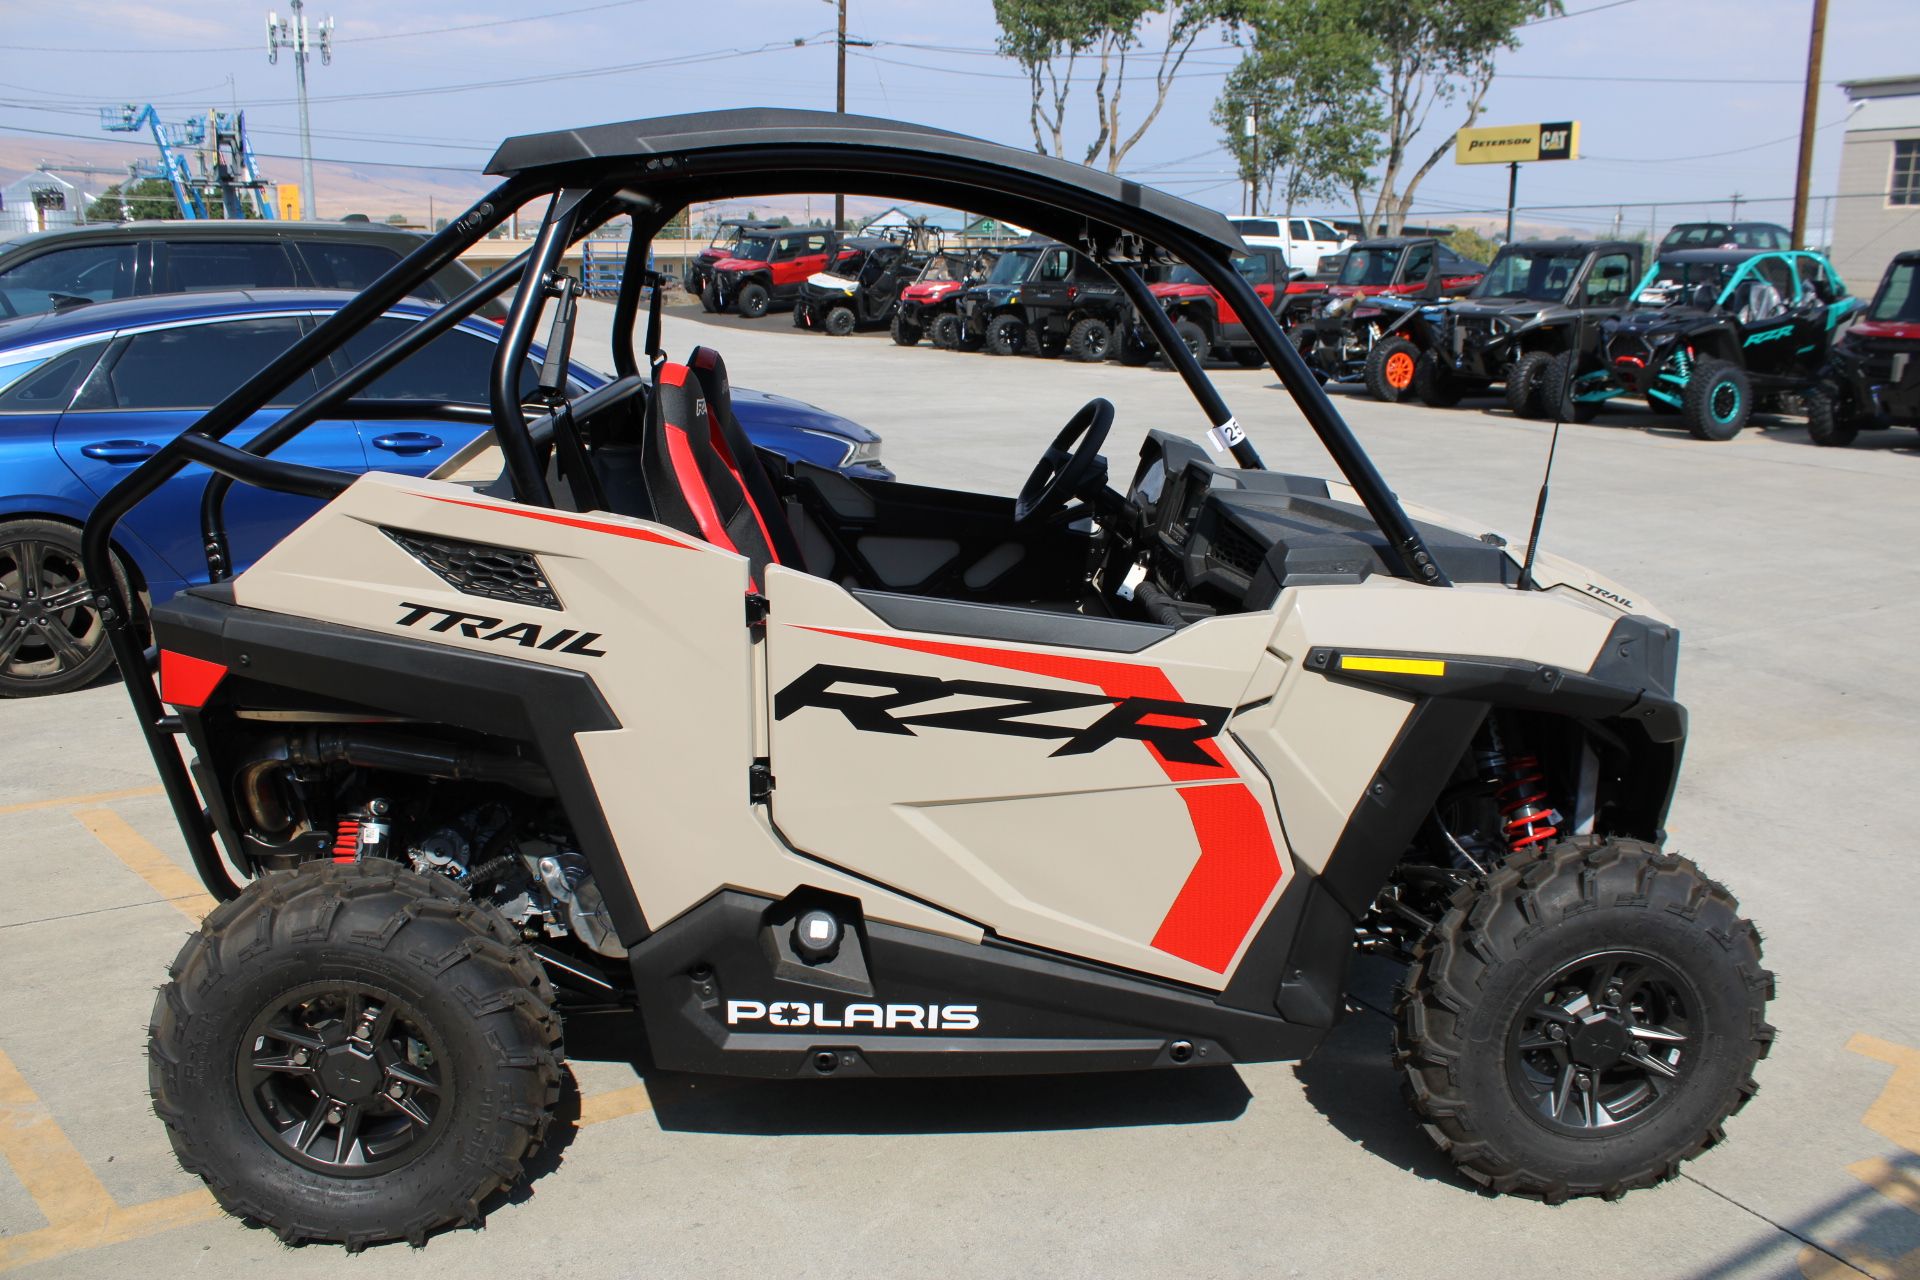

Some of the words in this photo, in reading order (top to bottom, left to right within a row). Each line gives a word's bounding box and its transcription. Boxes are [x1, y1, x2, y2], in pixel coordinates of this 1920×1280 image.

[1468, 137, 1534, 151] PETERSON
[1541, 130, 1568, 150] CAT
[1743, 324, 1796, 348] RZR
[1586, 583, 1633, 609] TRAIL
[395, 601, 607, 658] TRAIL
[774, 663, 1233, 768] RZR
[727, 1000, 980, 1030] POLARIS
